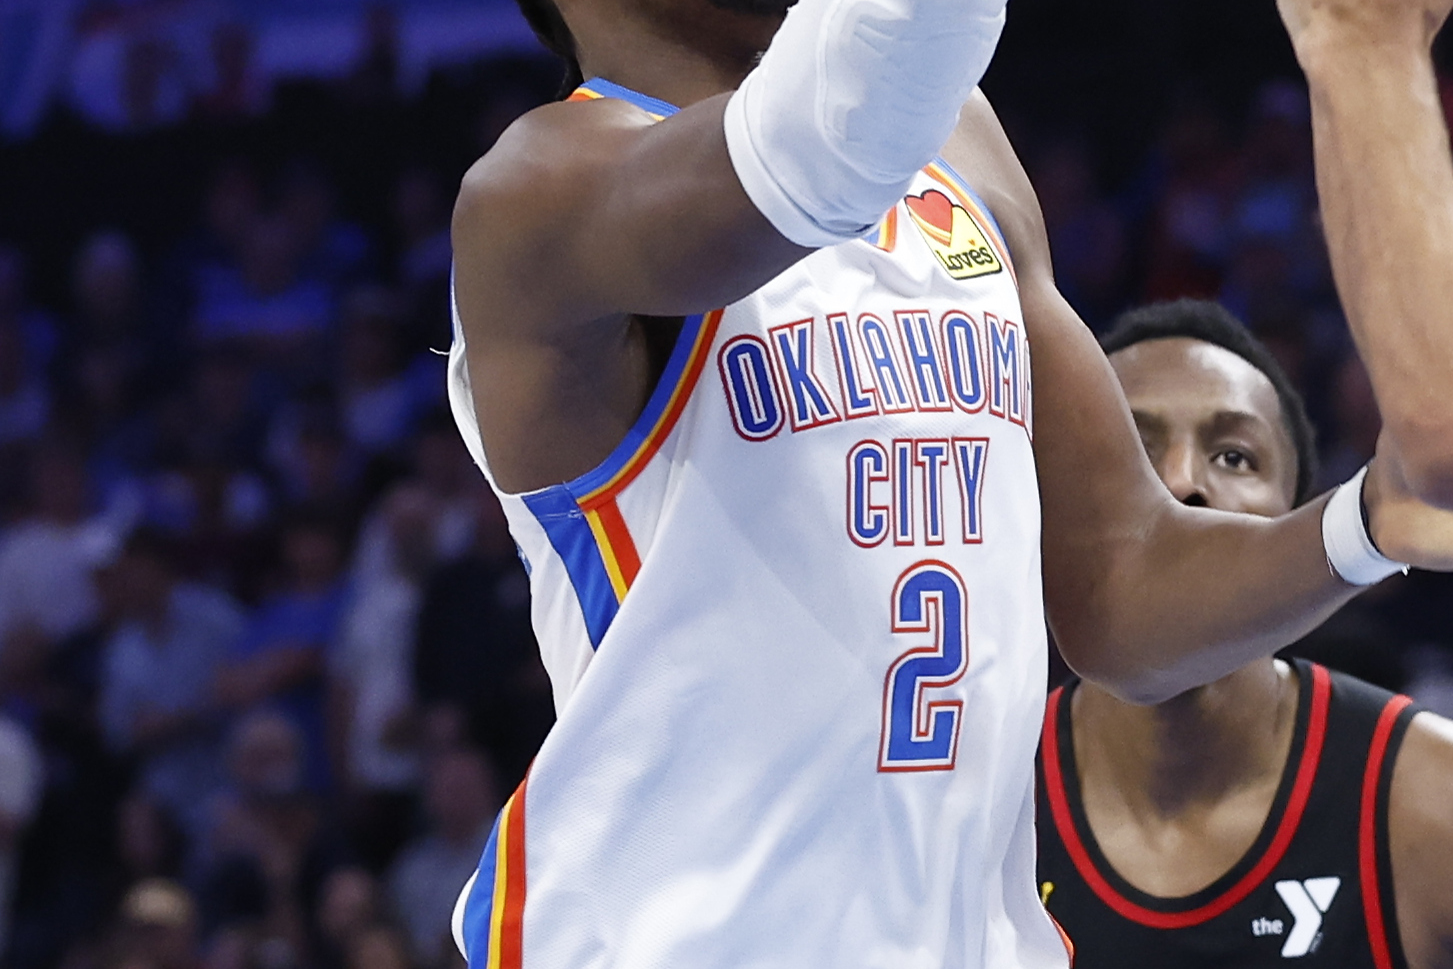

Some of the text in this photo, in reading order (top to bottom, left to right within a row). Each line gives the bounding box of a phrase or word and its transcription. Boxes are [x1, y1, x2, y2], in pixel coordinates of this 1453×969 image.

[717, 309, 1034, 442] OKLAHOM
[846, 436, 989, 548] CITY
[877, 558, 968, 773] 2
[1251, 917, 1284, 936] the
